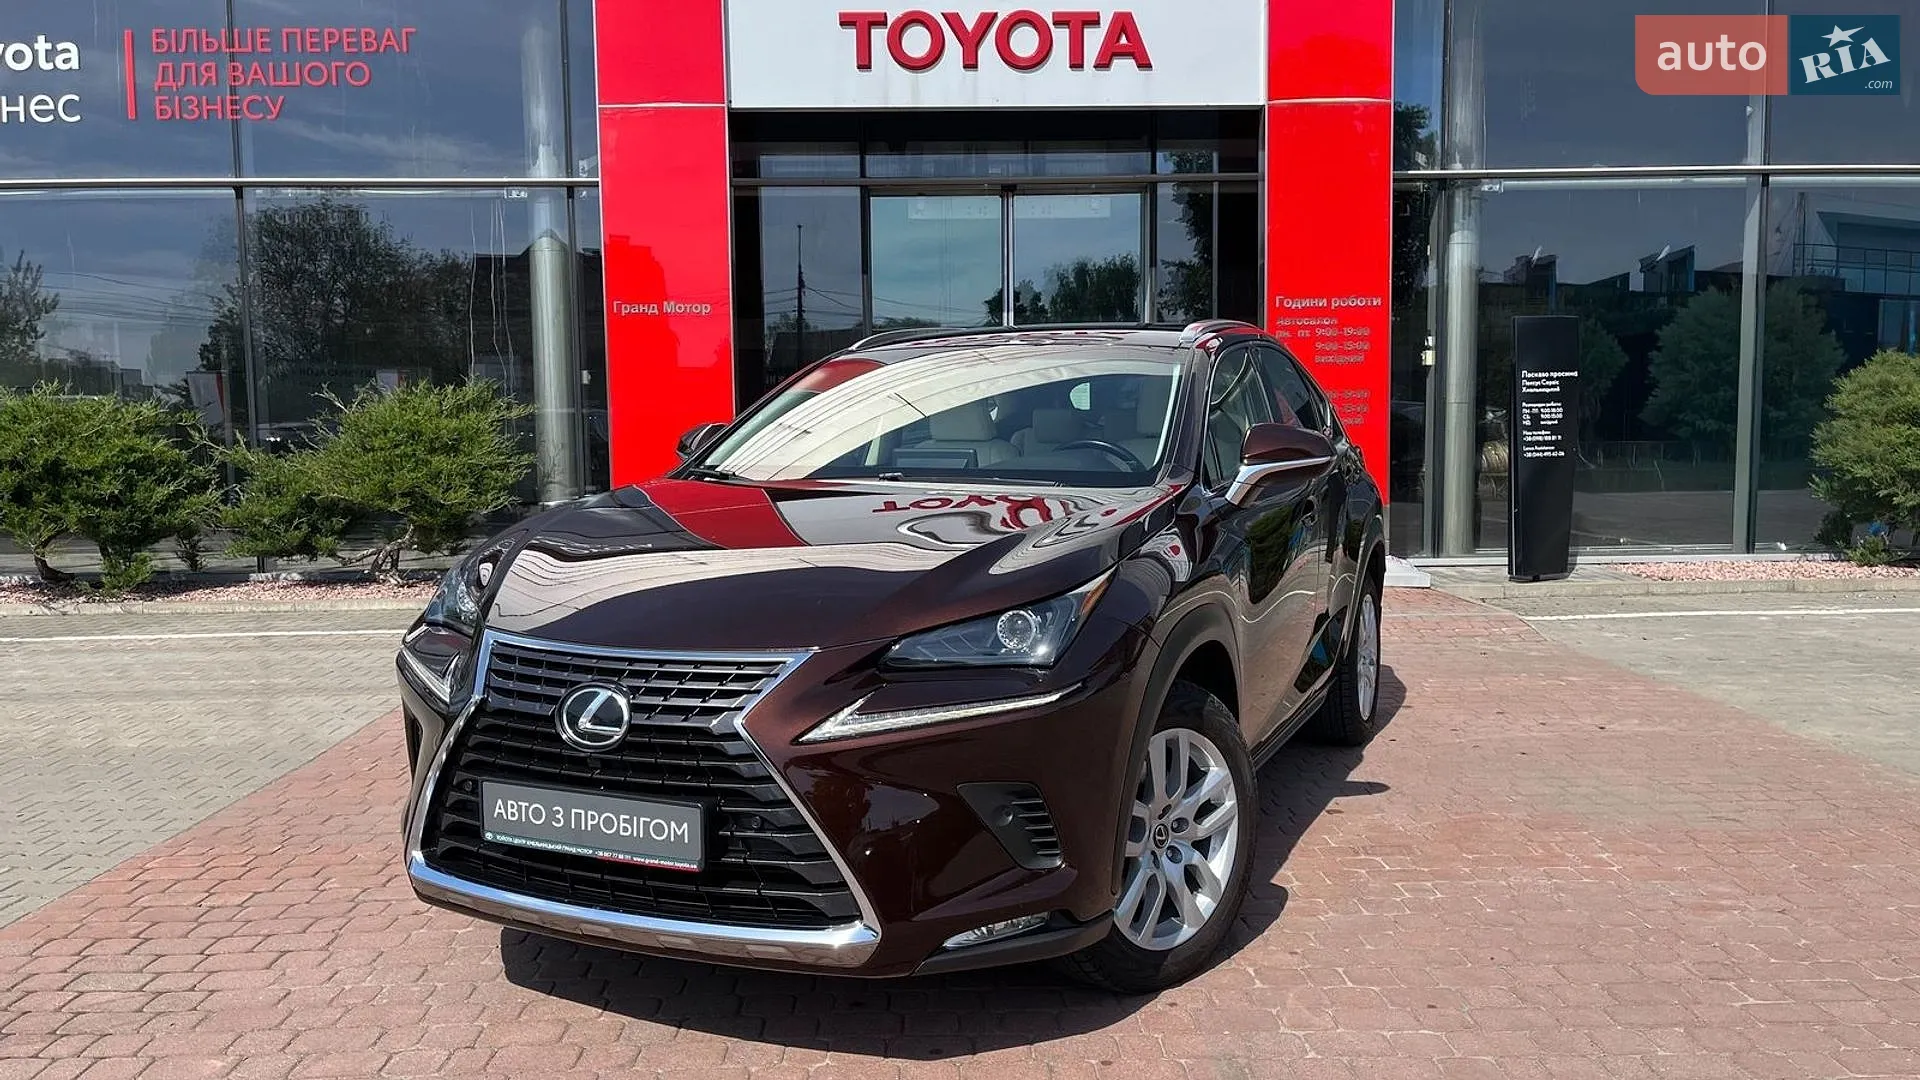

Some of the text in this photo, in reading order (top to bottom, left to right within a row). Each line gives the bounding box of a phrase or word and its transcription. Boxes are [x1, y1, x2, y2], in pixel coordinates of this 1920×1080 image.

[151, 28, 417, 54] БІЛЬШЕ ПЕРЕВАГ
[838, 10, 1153, 71] TOYOTA
[154, 61, 372, 91] ДЛЯ ВАШОГО
[155, 95, 285, 121] БІЗНЕСУ
[613, 300, 711, 315] Гранд Мотор
[1275, 295, 1382, 309] Години роботи
[493, 798, 689, 844] АВТО З ПРОБІГОМ
